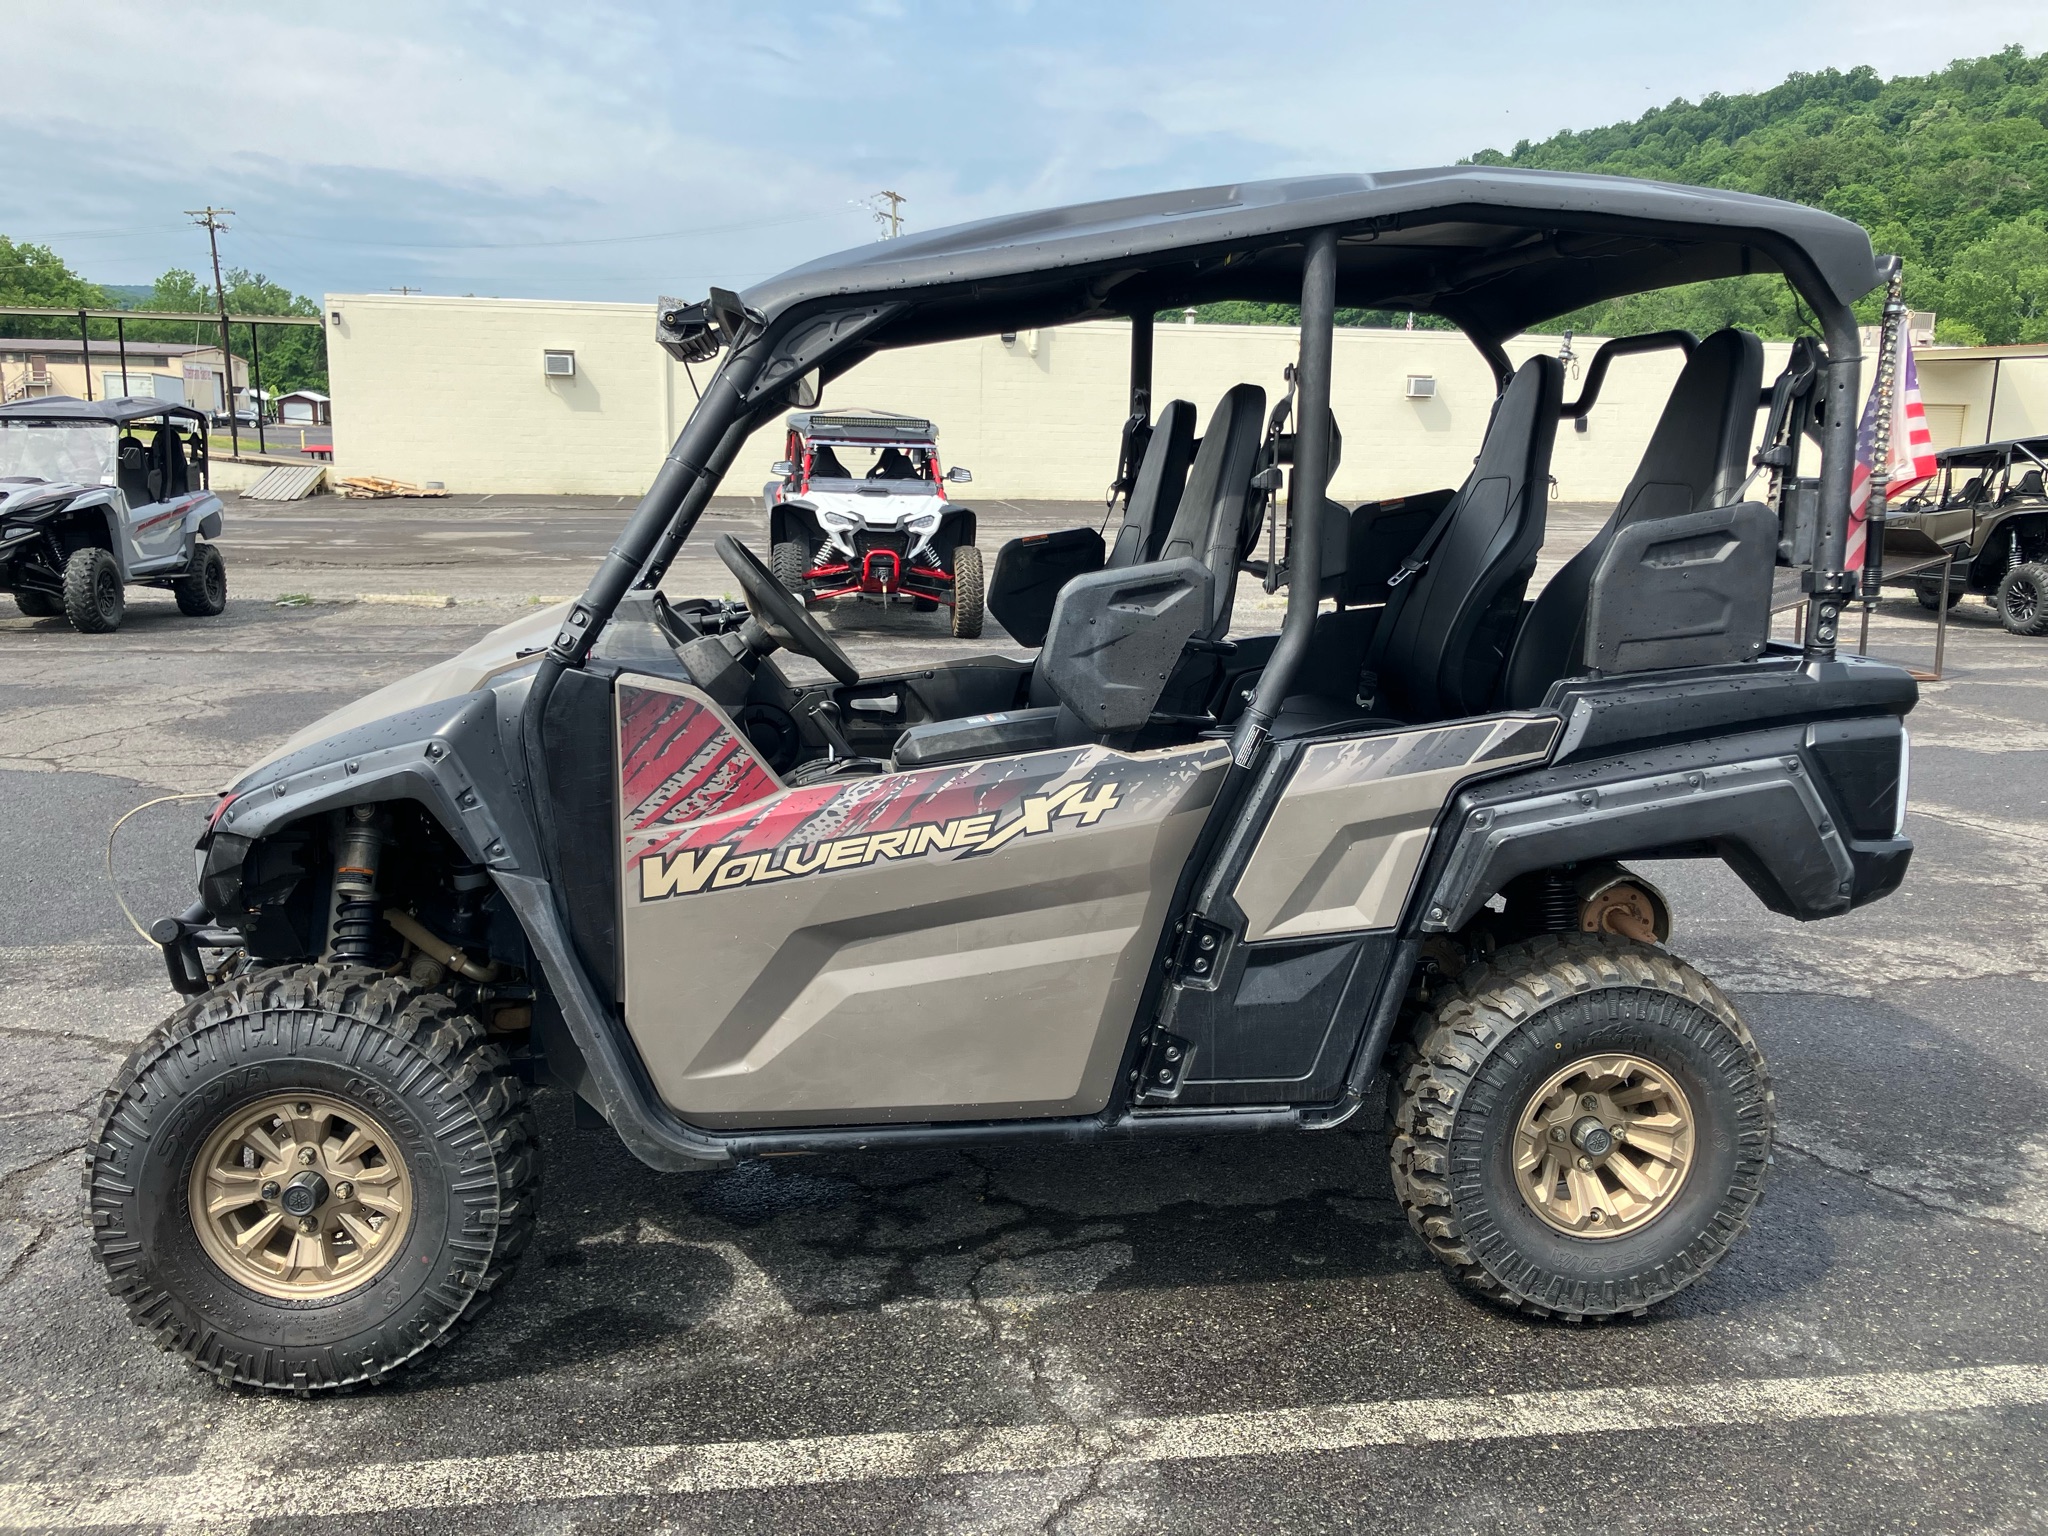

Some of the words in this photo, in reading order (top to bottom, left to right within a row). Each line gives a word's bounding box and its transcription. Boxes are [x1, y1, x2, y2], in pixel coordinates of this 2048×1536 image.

[641, 813, 1001, 901] WOLVERINE
[970, 782, 1123, 852] X4
[1551, 1239, 1661, 1274] SEDONA
